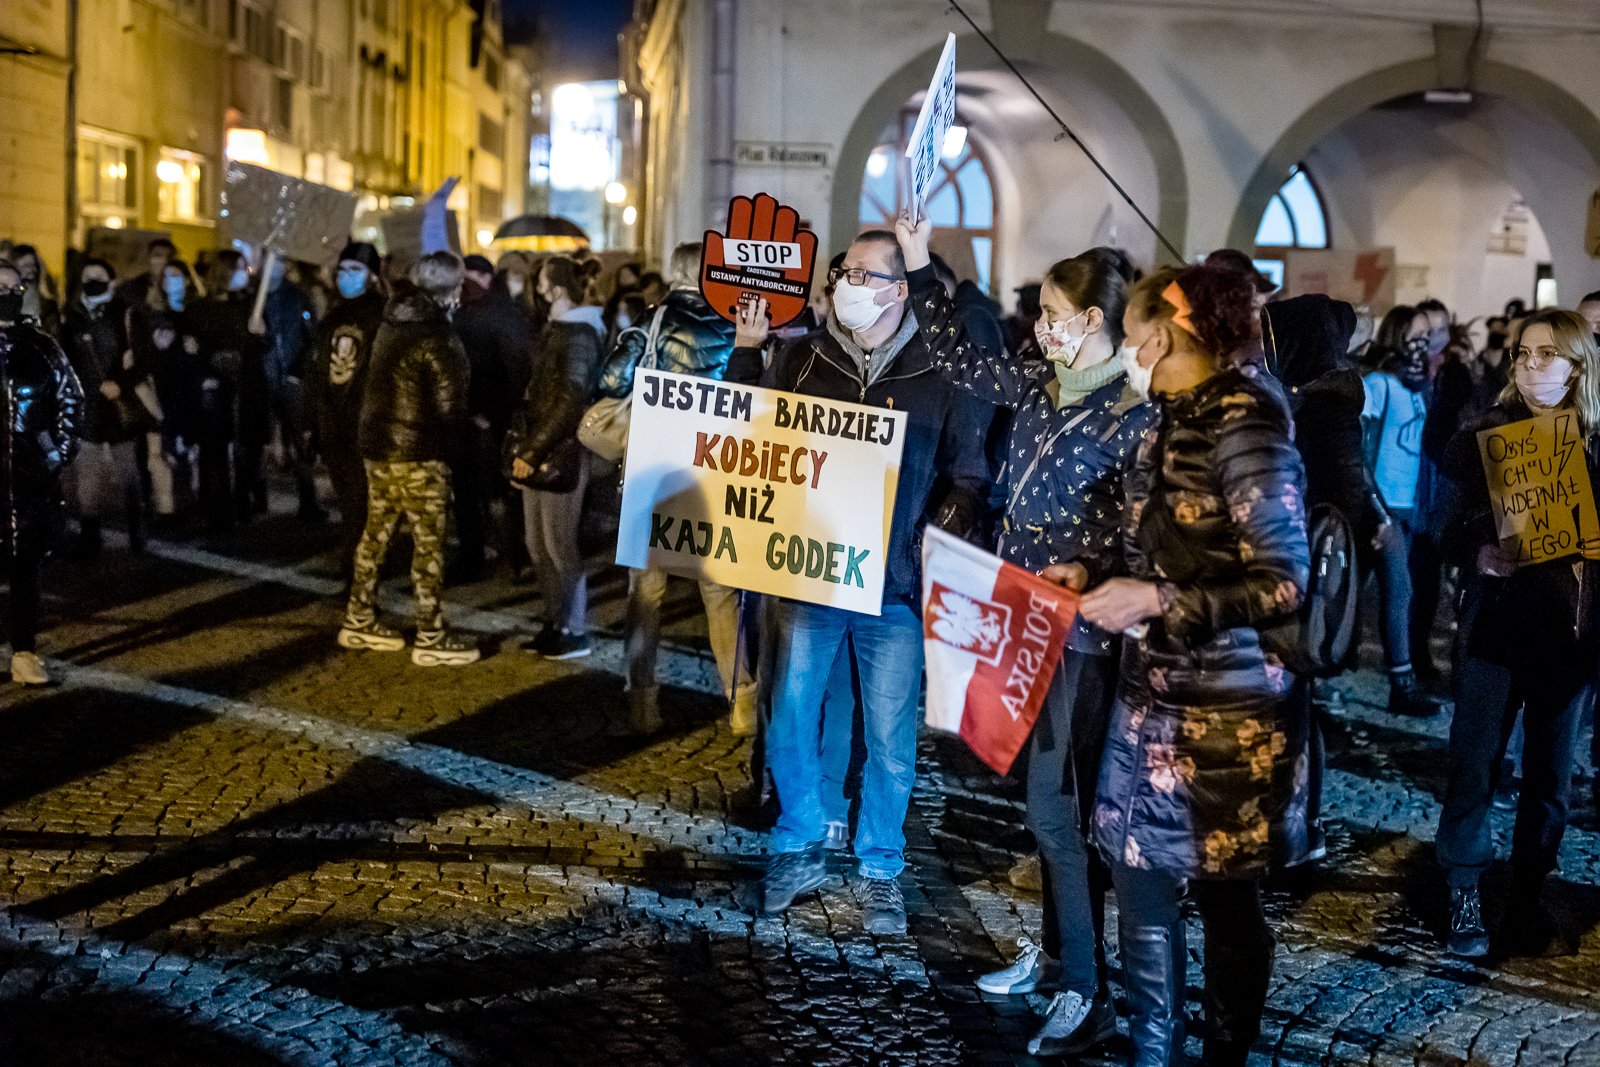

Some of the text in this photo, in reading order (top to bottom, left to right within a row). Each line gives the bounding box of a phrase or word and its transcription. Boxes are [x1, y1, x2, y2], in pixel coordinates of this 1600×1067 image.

[737, 243, 792, 264] STOP
[711, 270, 804, 294] USTAWY ANTYABORCYJNEJ
[642, 375, 753, 422] JESTEM
[1501, 476, 1580, 517] WDEPNĄŁ
[1531, 509, 1550, 533] W
[649, 513, 870, 589] KAJA GODEK
